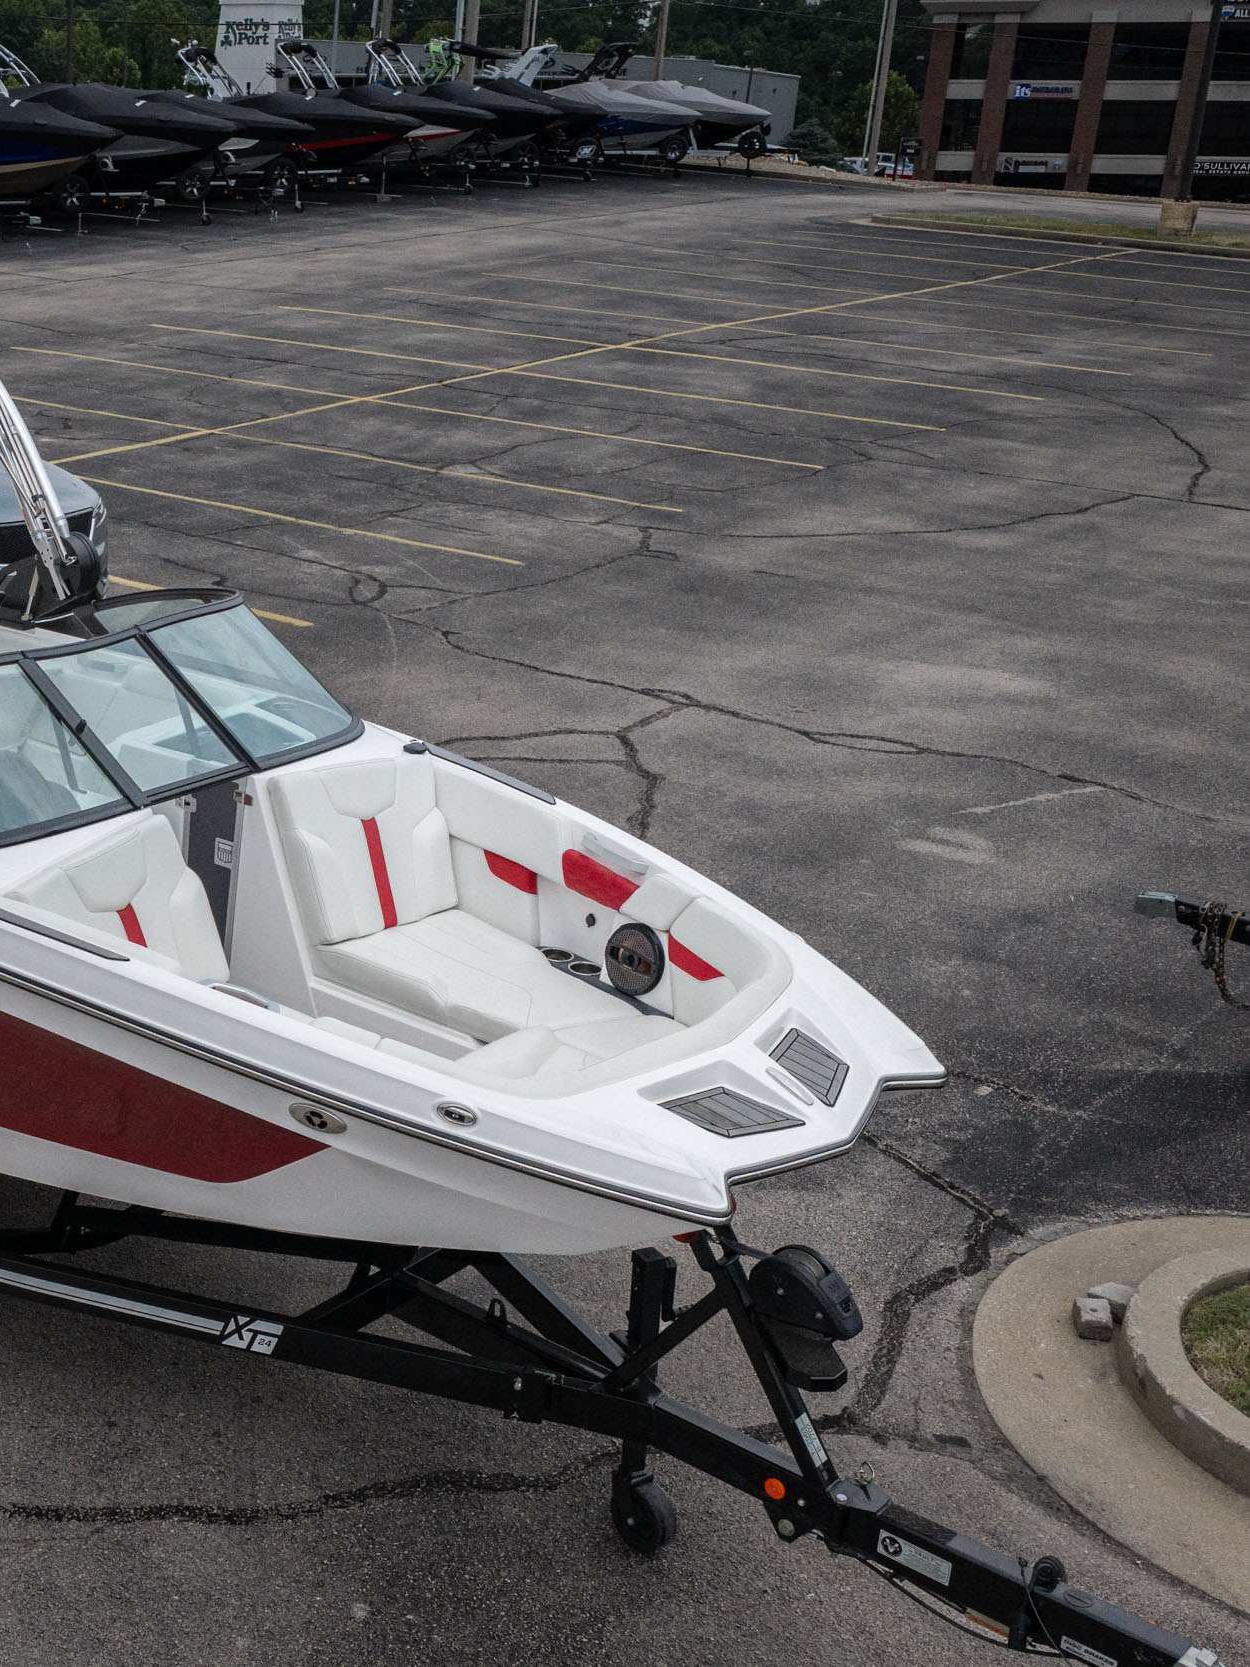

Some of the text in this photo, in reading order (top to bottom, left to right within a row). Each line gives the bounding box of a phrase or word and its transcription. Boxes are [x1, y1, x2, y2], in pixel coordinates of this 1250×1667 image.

[225, 18, 270, 35] Kelly's
[237, 32, 269, 45] Port
[1194, 162, 1250, 170] O'SULLIVA
